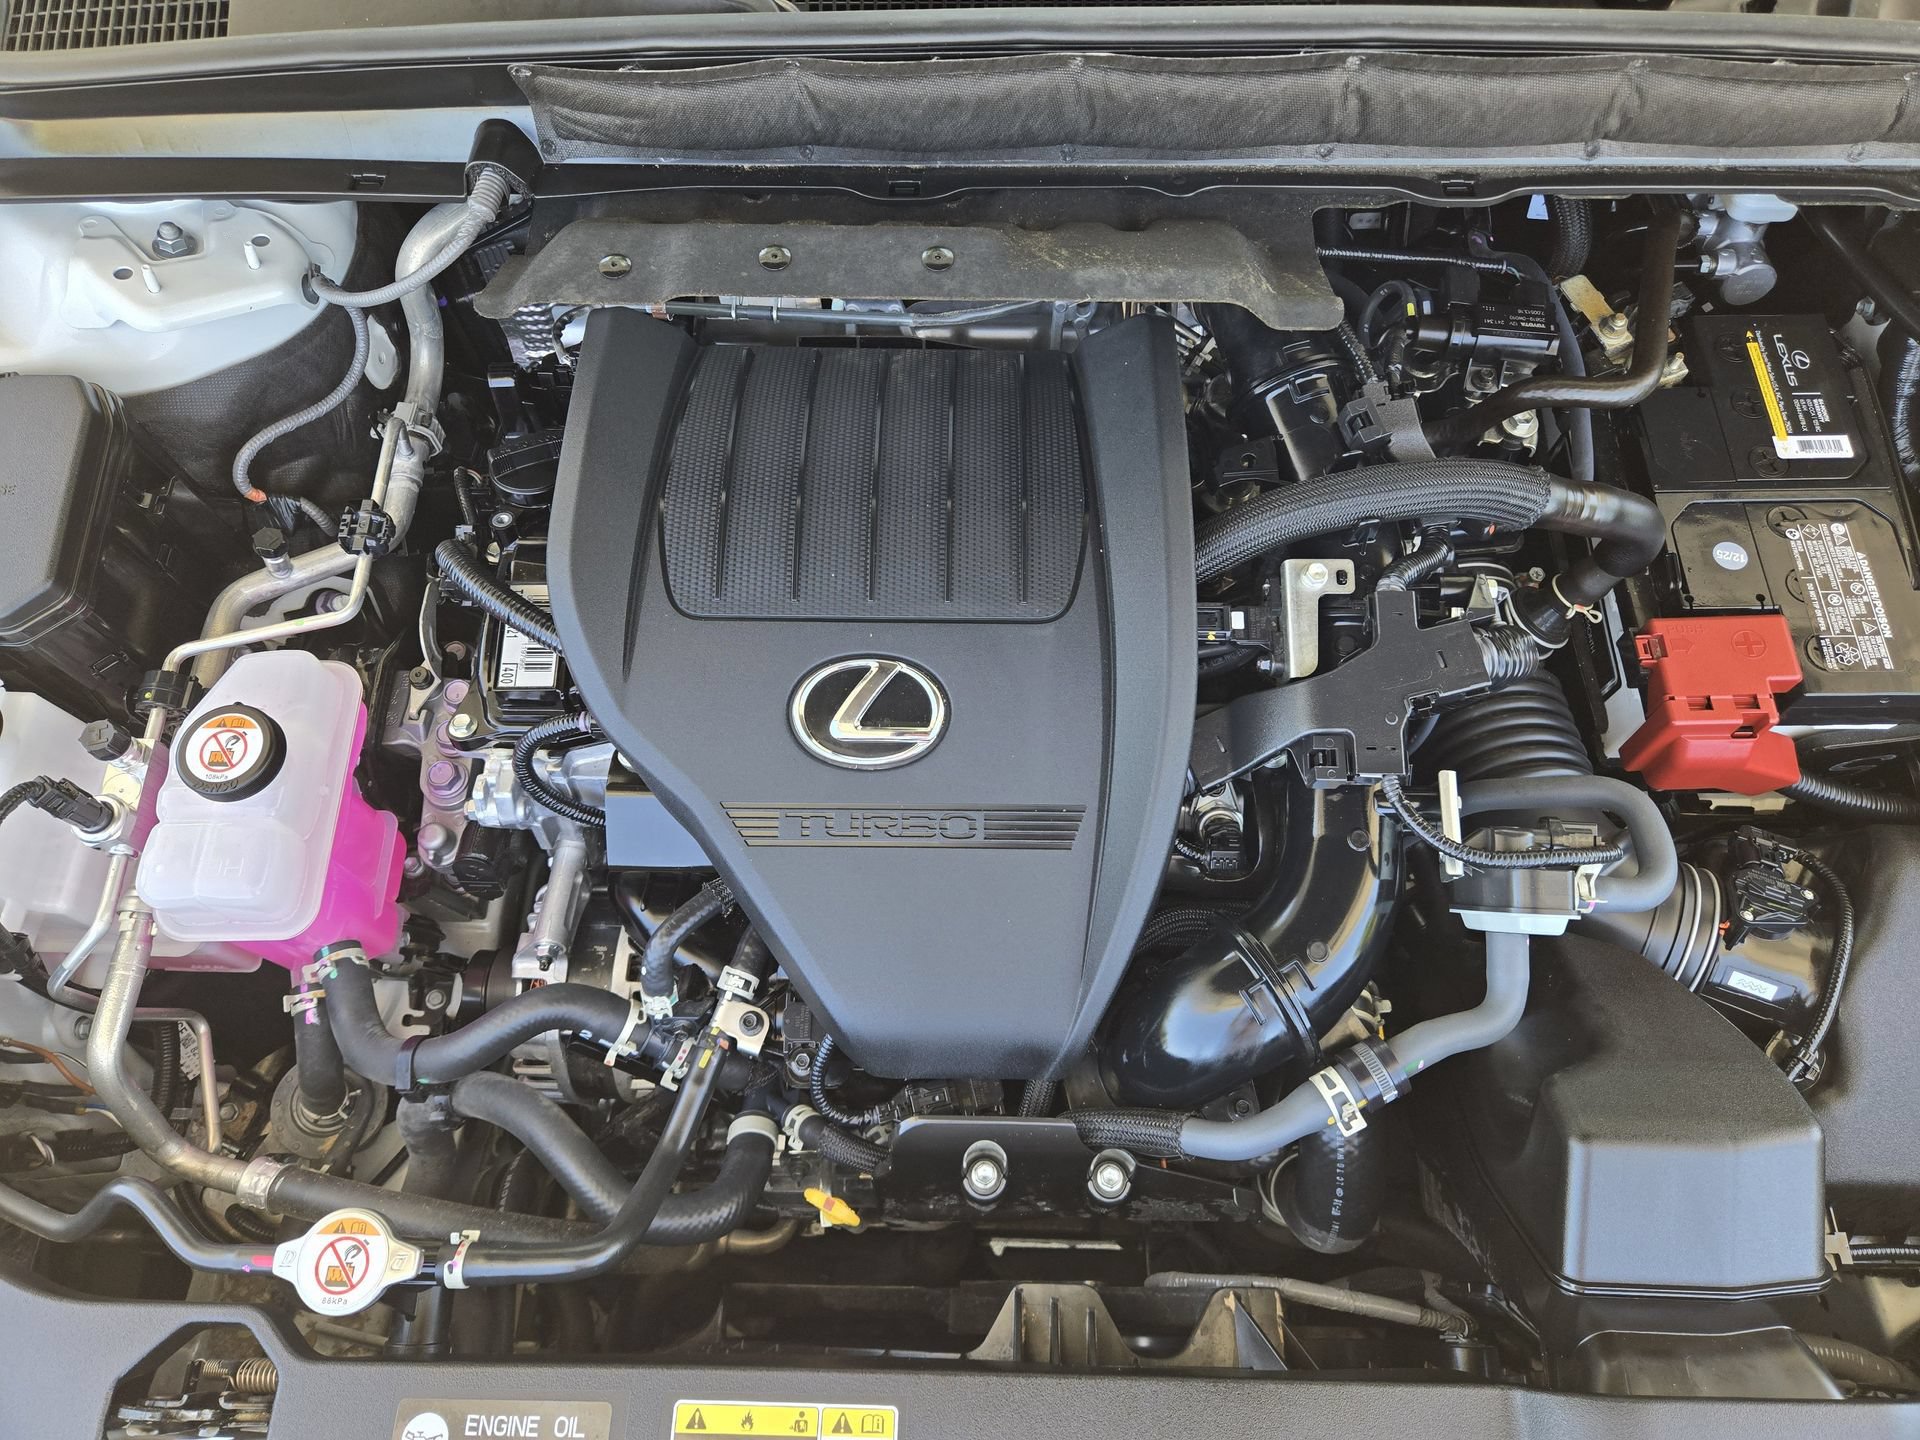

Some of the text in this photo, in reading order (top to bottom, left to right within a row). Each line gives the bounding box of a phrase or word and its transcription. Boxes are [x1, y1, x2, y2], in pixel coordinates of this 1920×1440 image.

[1773, 334, 1798, 387] LEXUS
[1716, 550, 1746, 562] 12/25
[1859, 559, 1893, 638] DANGER/POISON
[1824, 638, 1836, 658] BATTERY
[500, 666, 515, 684] 400
[192, 779, 239, 792] DENSO
[785, 811, 977, 840] TURBO
[464, 1414, 585, 1438] ENGINE OIL
